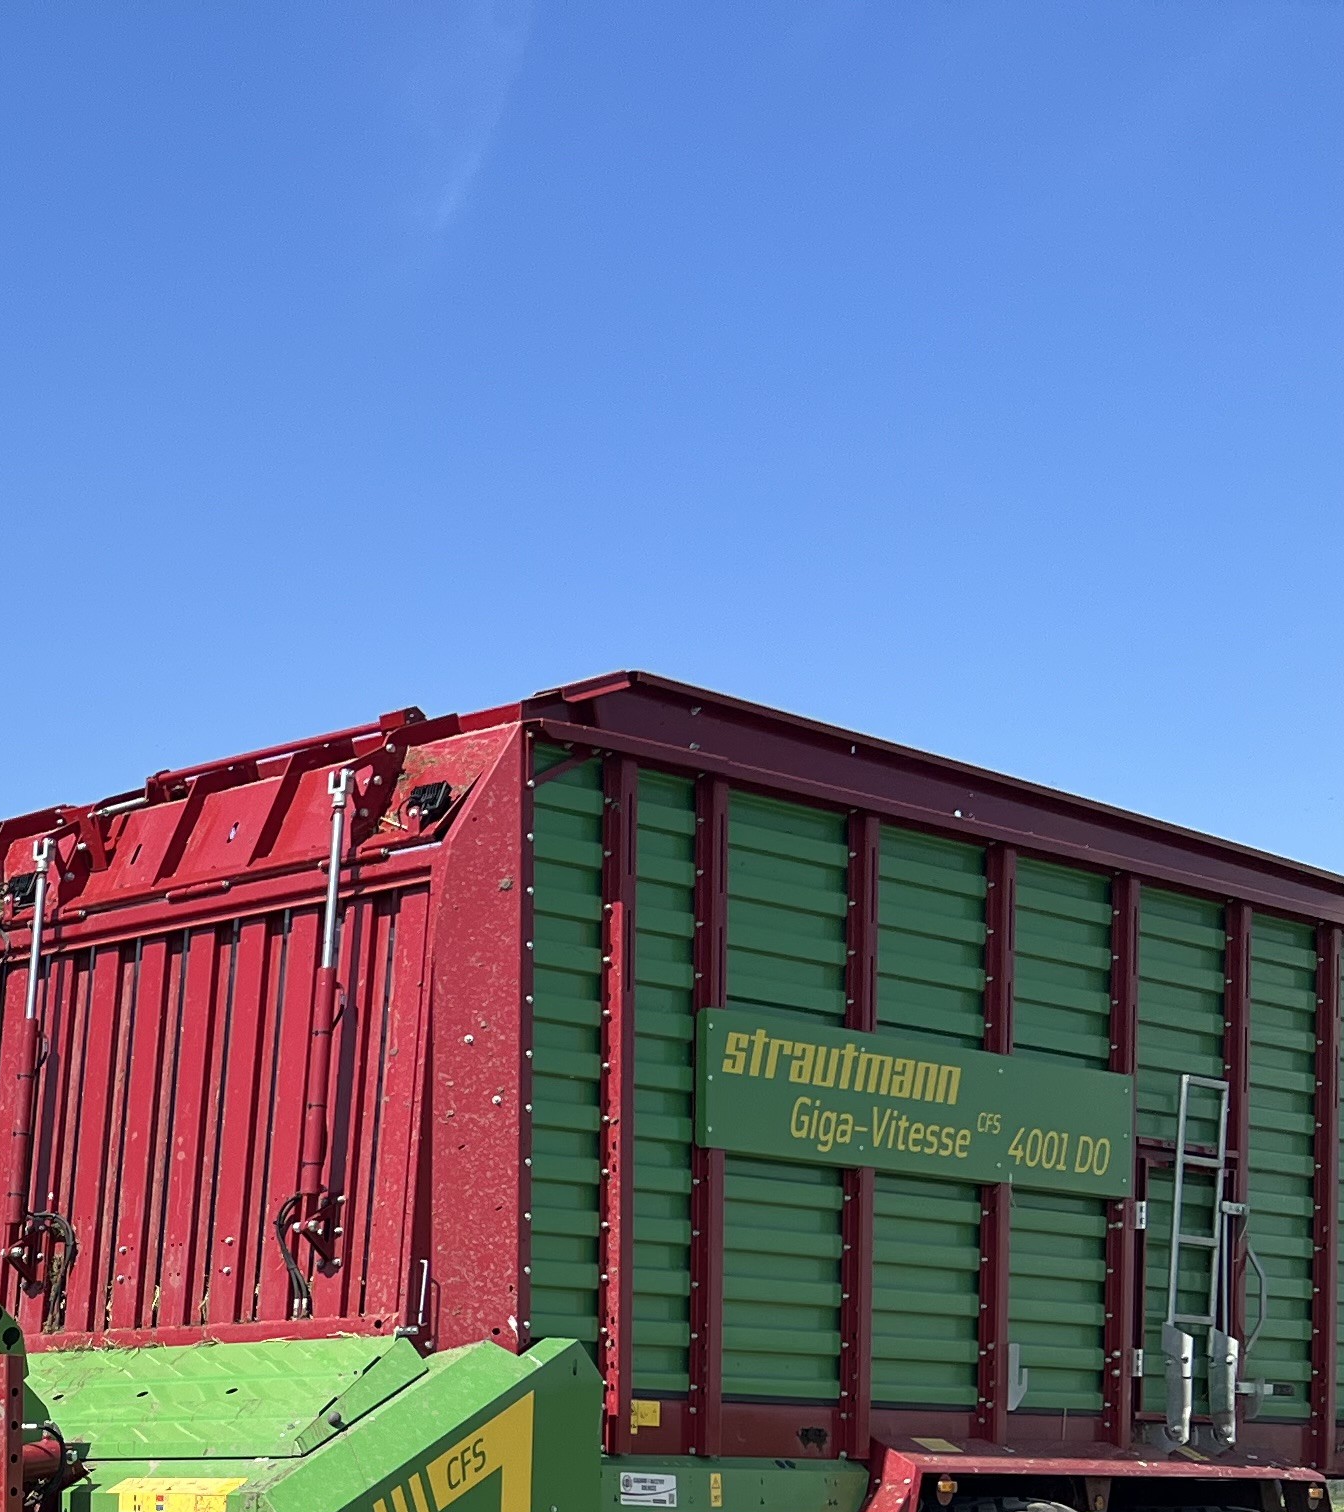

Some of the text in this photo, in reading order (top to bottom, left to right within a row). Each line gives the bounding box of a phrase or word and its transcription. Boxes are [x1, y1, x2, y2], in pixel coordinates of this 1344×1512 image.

[722, 1029, 962, 1106] strautmann
[791, 1096, 1111, 1177] Giga-Vitesse CFS 4001 DO
[446, 1437, 487, 1490] CFS
